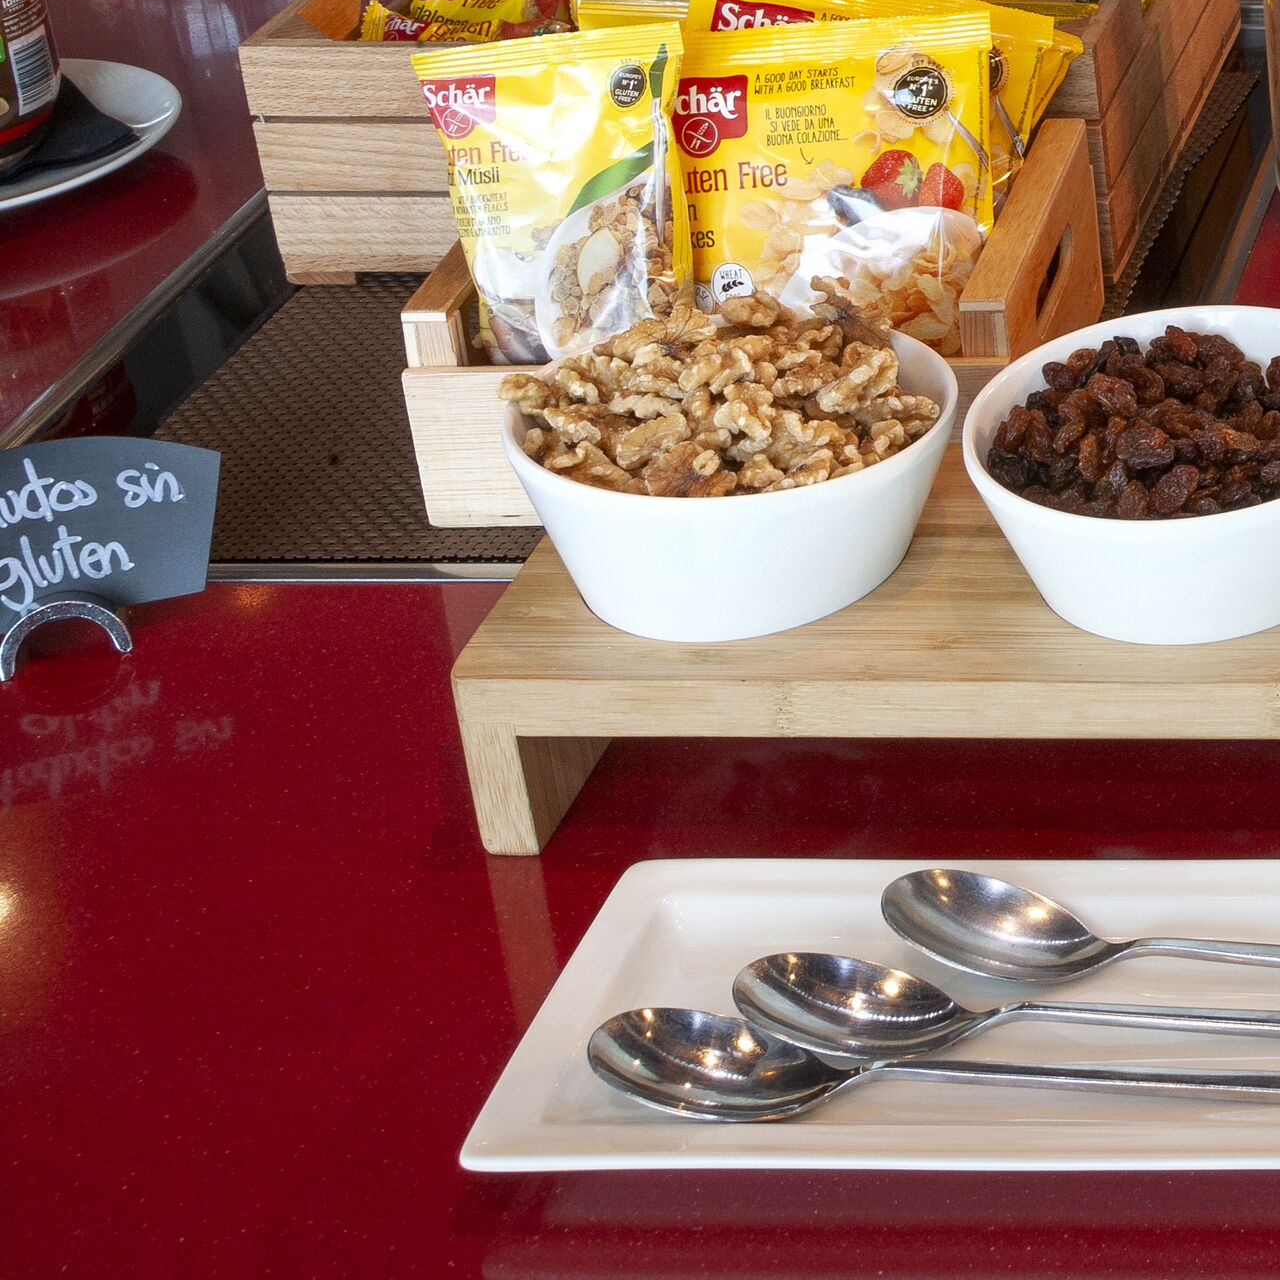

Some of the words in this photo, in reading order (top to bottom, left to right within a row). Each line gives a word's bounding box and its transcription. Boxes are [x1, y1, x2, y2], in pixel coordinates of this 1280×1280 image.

[717, 2, 812, 32] Sch
[755, 73, 761, 83] A
[765, 72, 785, 83] GOOD
[789, 70, 803, 81] DAY
[806, 67, 839, 79] STARTS
[614, 88, 640, 97] GLUTEN
[754, 84, 774, 95] WITH
[777, 83, 783, 93] A
[786, 80, 807, 92] GOOD
[810, 76, 856, 90] BREAKFAST
[423, 83, 491, 108] Schär
[674, 85, 742, 119] chär
[900, 94, 938, 107] GLUTEN
[765, 108, 772, 120] IL
[776, 104, 827, 120] BUONGIORNO
[907, 104, 928, 112] FREE
[782, 120, 801, 132] VEDE
[804, 119, 815, 130] DA
[818, 117, 835, 129] UNA
[766, 133, 793, 146] BUONA
[457, 167, 501, 186] Müsli
[685, 165, 729, 195] uten
[738, 160, 788, 190] Free
[690, 229, 716, 249] kes
[719, 268, 743, 280] WHEAT
[0, 457, 98, 529] uctos
[115, 461, 186, 509] sin
[0, 524, 135, 613] gluten
